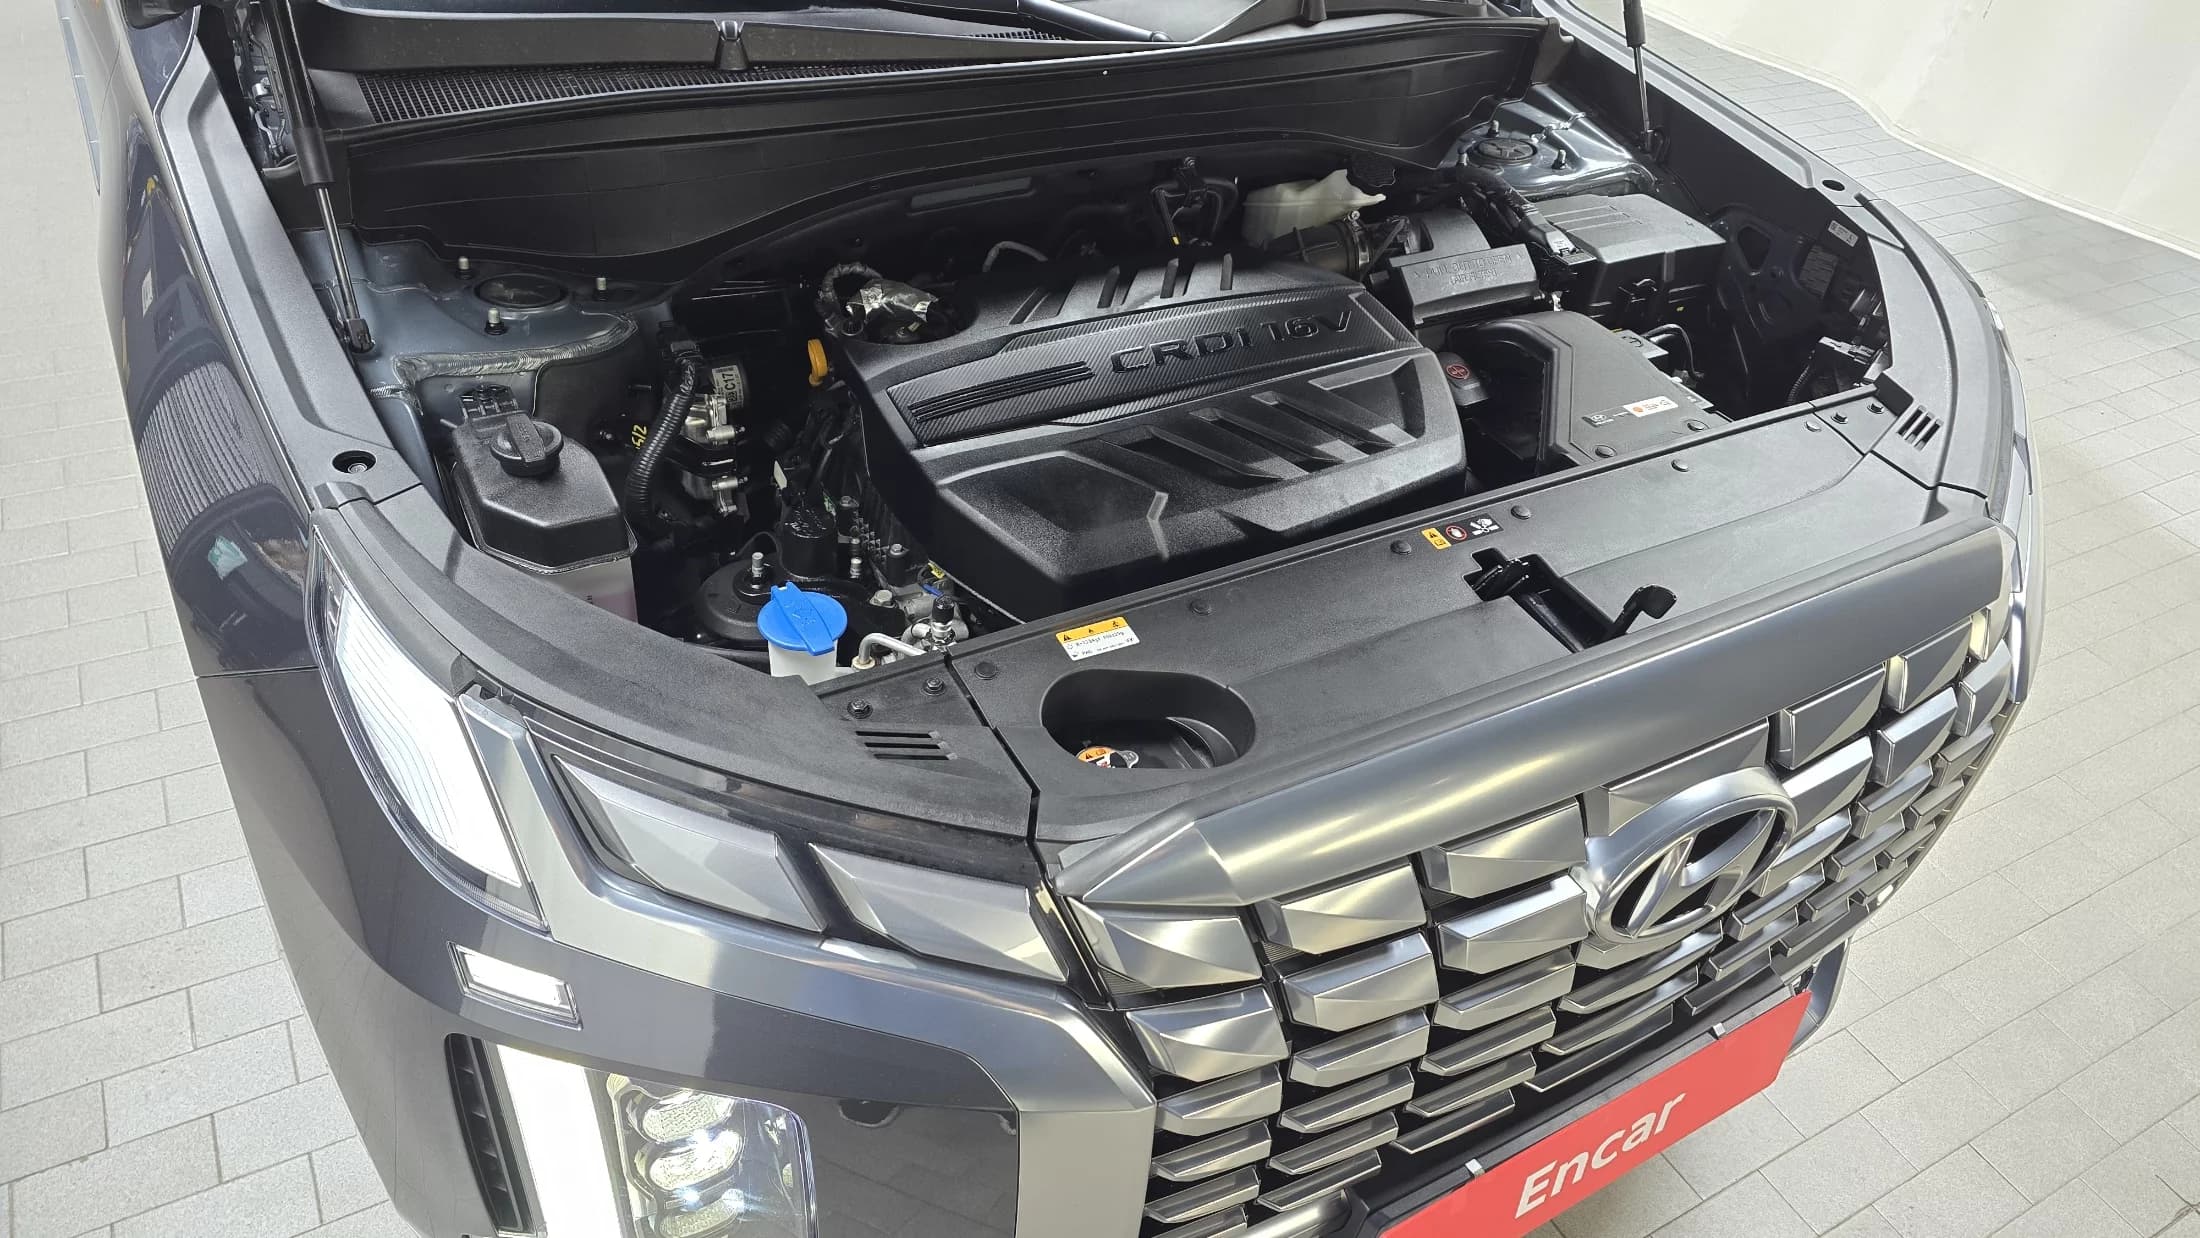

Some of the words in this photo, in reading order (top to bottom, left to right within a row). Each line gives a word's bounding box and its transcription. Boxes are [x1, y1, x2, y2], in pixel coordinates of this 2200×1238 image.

[1110, 327, 1253, 374] CRDI
[1260, 310, 1352, 345] 16V
[722, 373, 736, 391] C17
[1515, 1092, 1687, 1220] Encar
